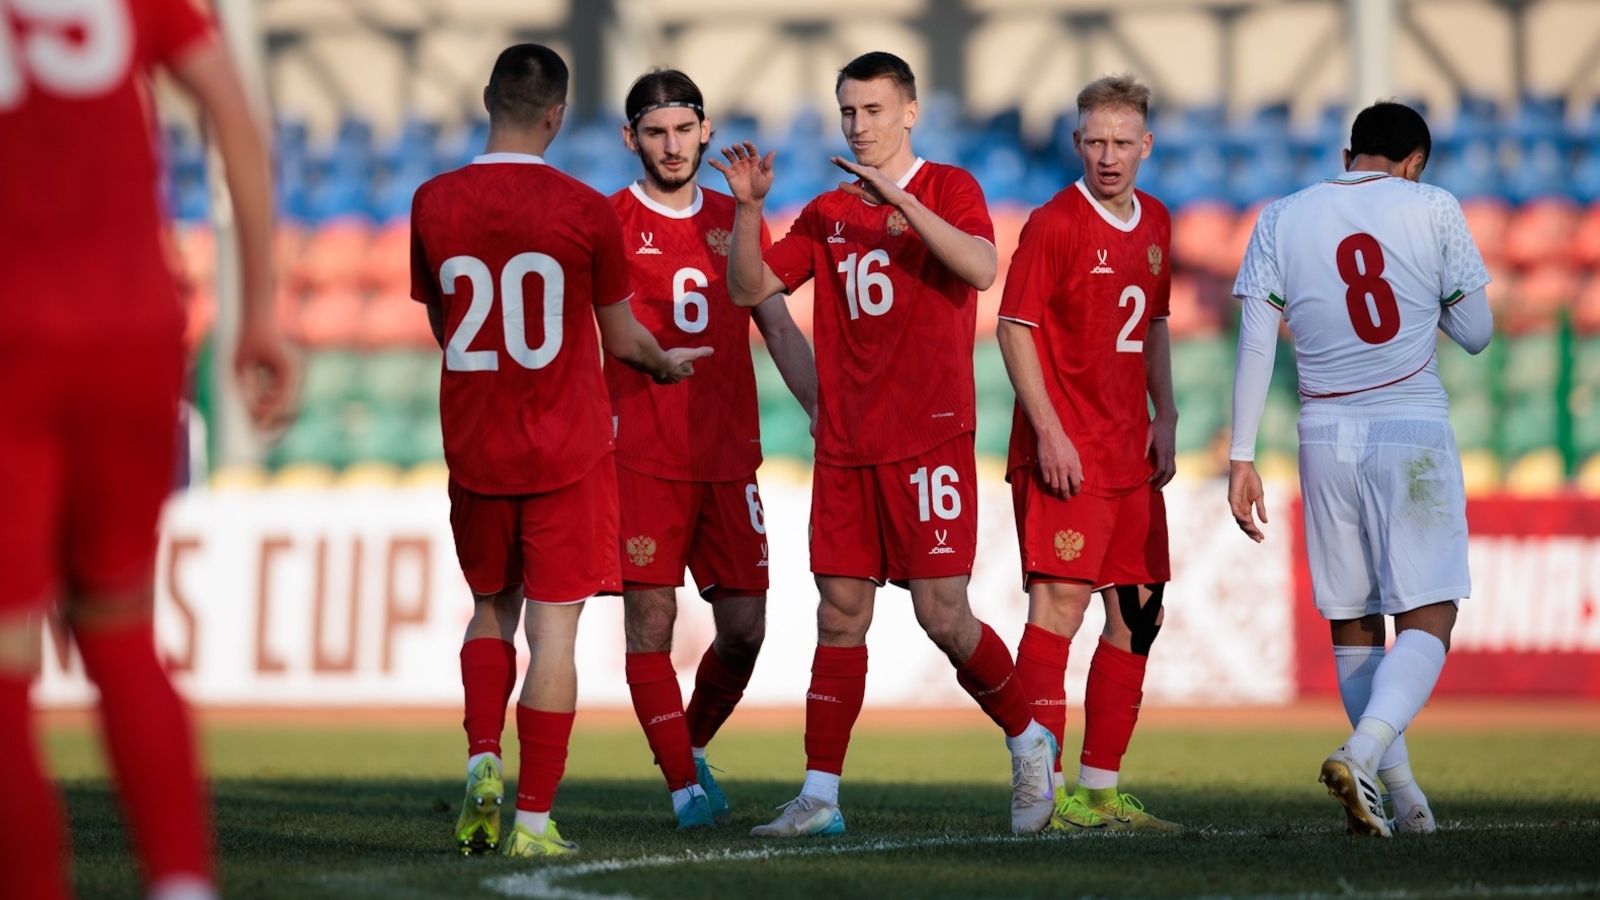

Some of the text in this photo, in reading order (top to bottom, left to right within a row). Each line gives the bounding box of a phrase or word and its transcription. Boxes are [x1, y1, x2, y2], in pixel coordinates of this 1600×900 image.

[439, 251, 565, 371] 20
[672, 267, 709, 334] 6
[838, 249, 894, 320] 16
[1336, 232, 1401, 345] 8
[1115, 285, 1147, 353] 2
[745, 483, 766, 535] 6
[909, 465, 962, 522] 16
[928, 546, 956, 555] JÖGEL
[253, 536, 434, 675] CUP
[806, 691, 843, 704] ÖGEL
